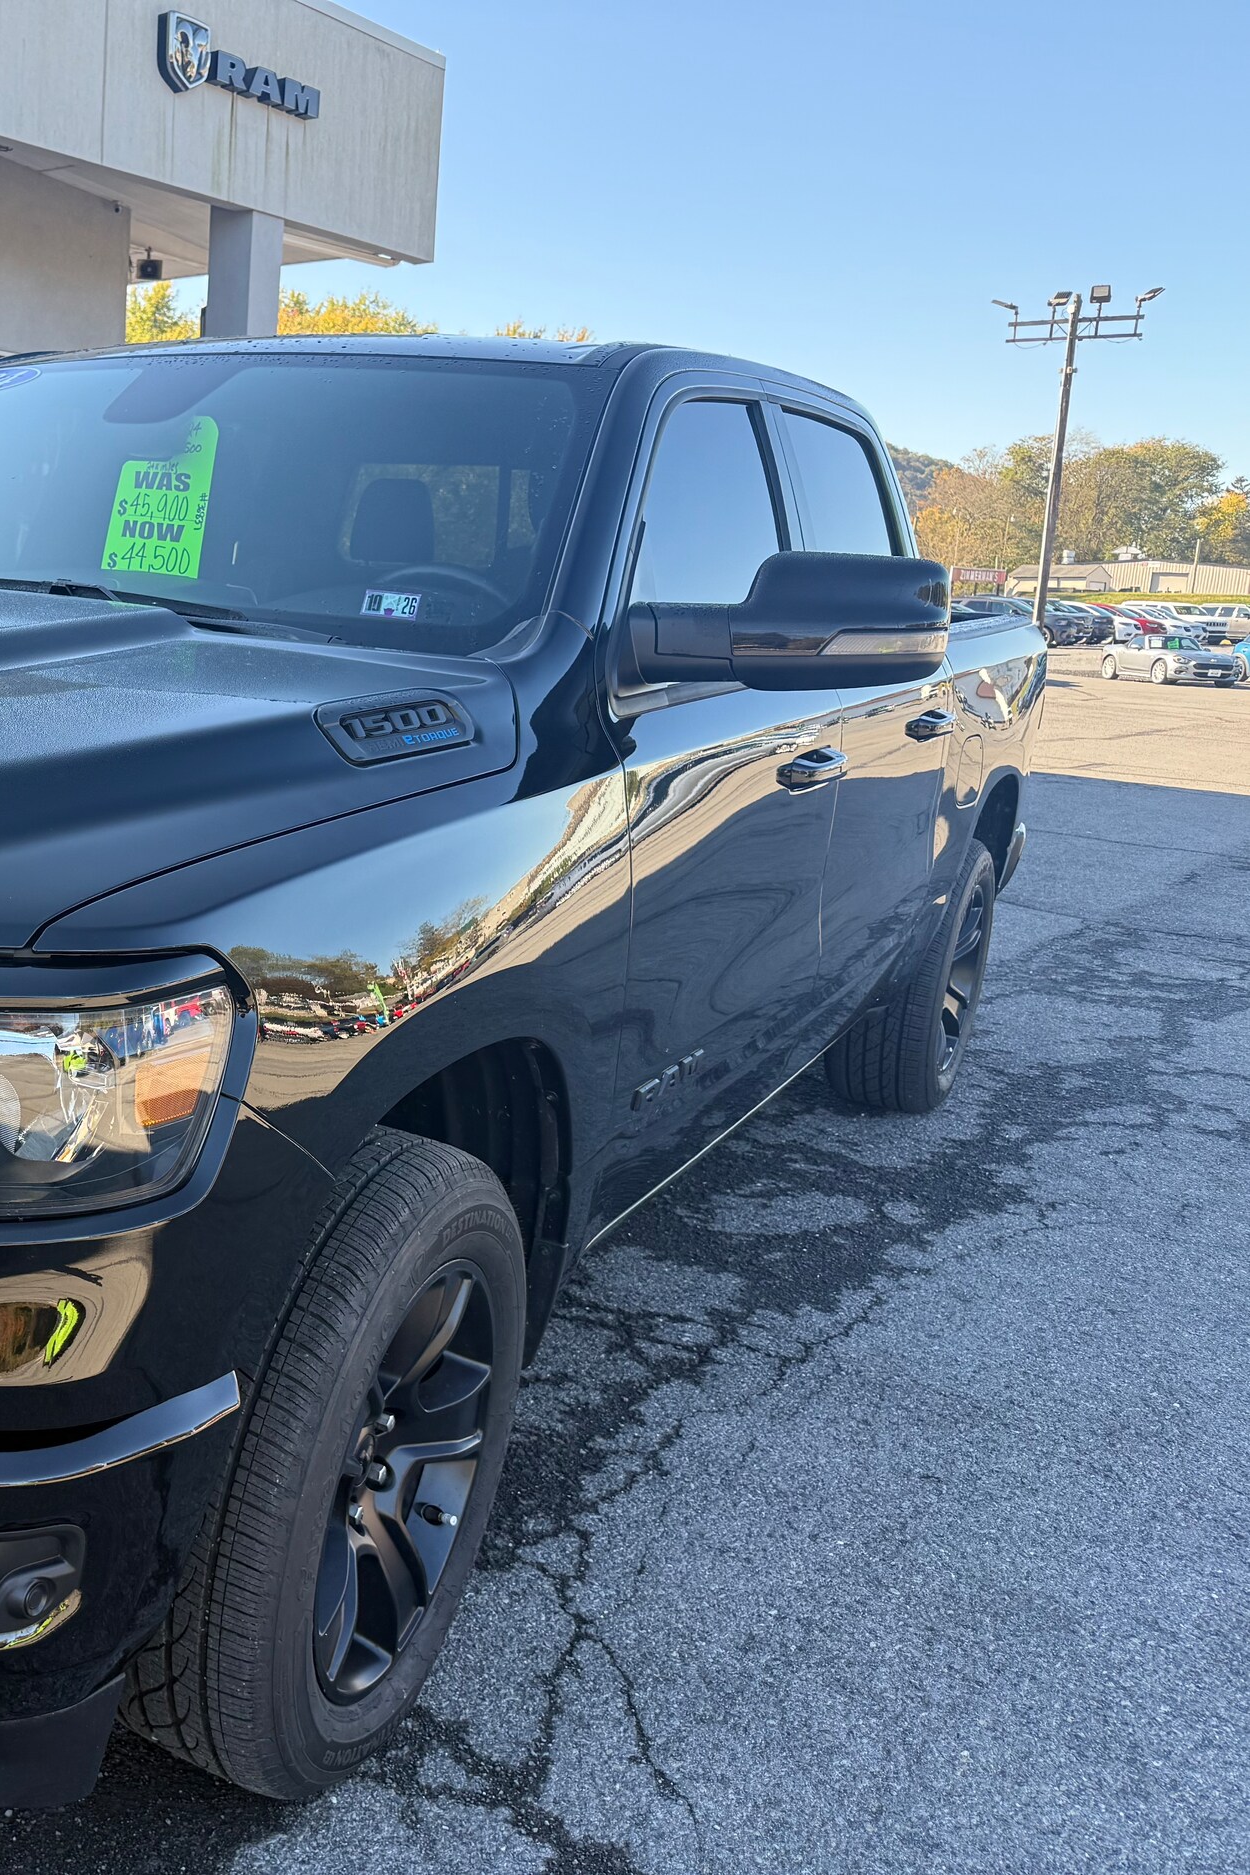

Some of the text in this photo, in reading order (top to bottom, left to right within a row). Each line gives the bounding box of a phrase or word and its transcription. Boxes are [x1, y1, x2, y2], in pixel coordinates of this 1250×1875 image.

[206, 50, 321, 120] RAM
[134, 471, 191, 492] WAS
[117, 492, 190, 521] $45,900
[121, 519, 186, 543] NOW
[107, 542, 191, 575] $44,500
[366, 594, 383, 611] 10
[401, 597, 417, 615] 26
[344, 705, 447, 739] 1500
[441, 1209, 508, 1249] DESTINATION
